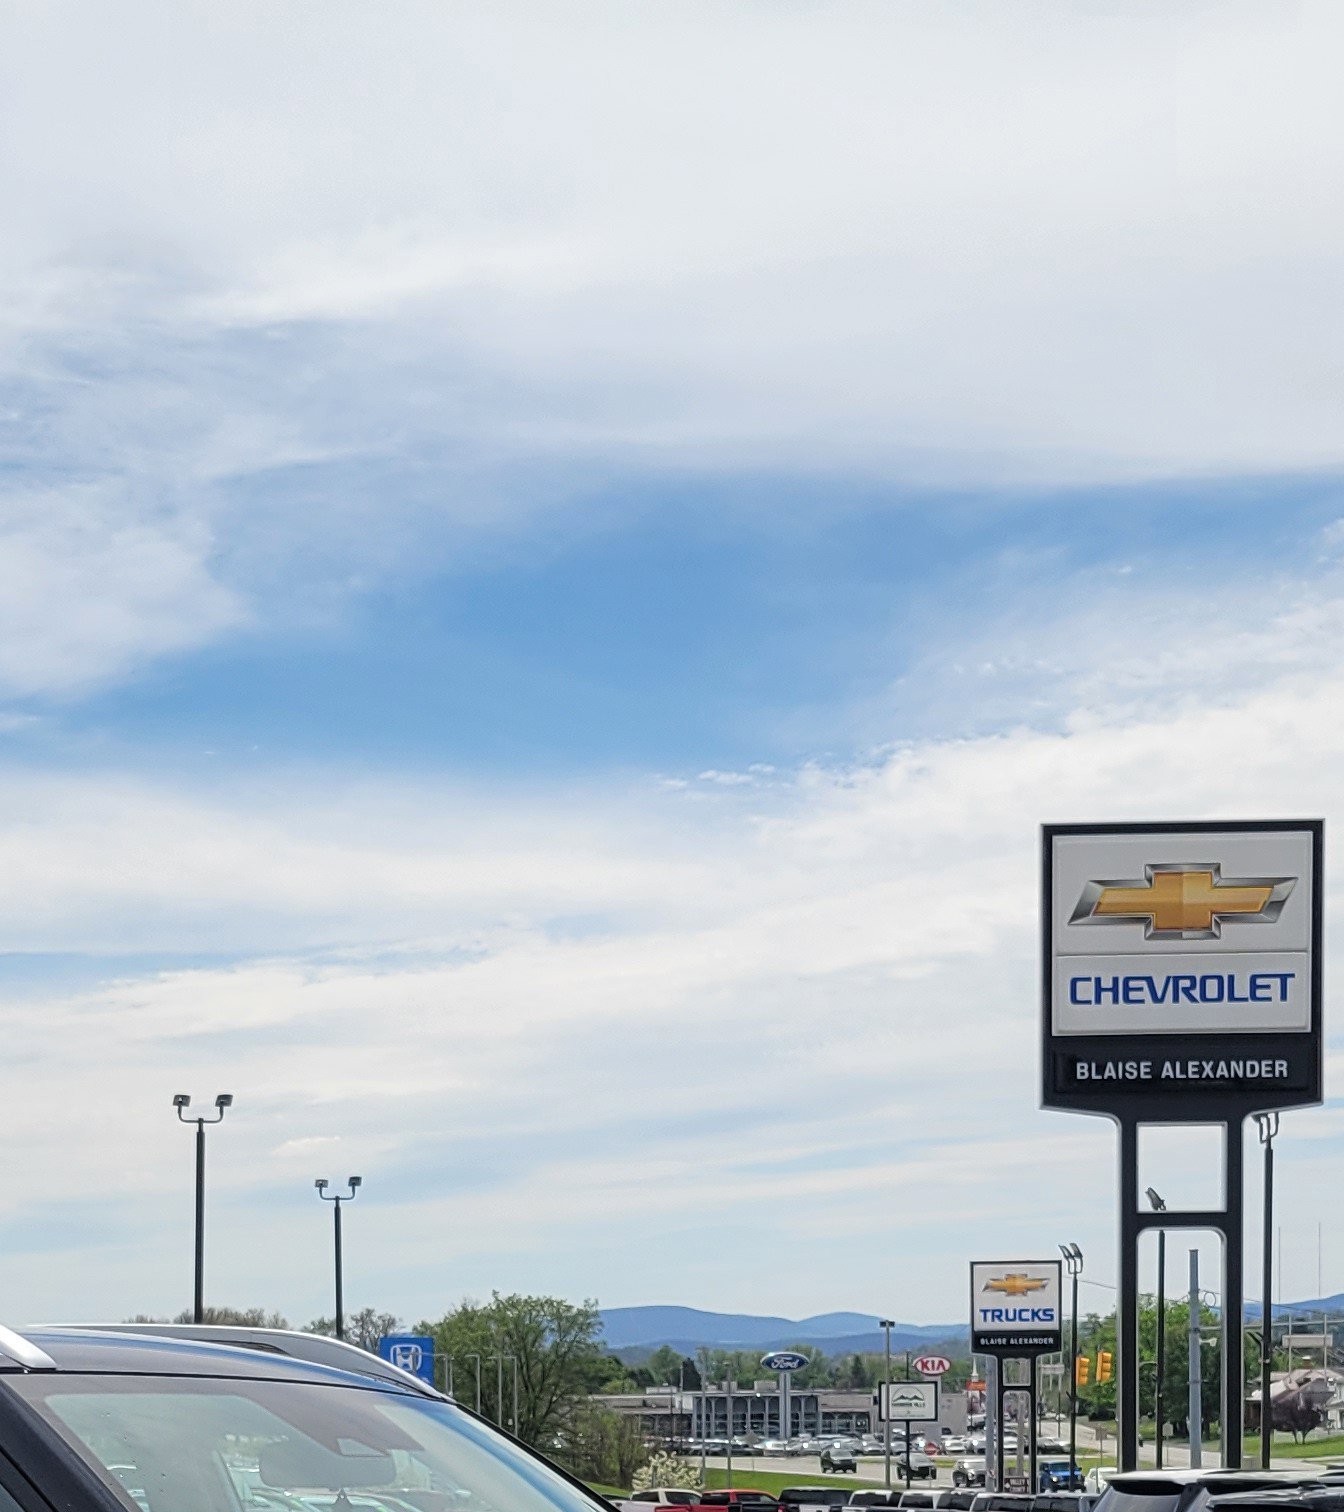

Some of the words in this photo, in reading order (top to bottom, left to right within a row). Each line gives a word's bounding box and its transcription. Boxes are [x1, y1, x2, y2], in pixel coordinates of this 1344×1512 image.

[1069, 973, 1296, 1006] CHEVROLET
[1076, 1061, 1152, 1080] BLAISE
[1161, 1059, 1289, 1079] ALEXANDER
[979, 1308, 1054, 1322] TRUCKS
[1010, 1337, 1054, 1345] ALEXANDER
[771, 1356, 799, 1369] Ford
[920, 1359, 946, 1371] KIA
